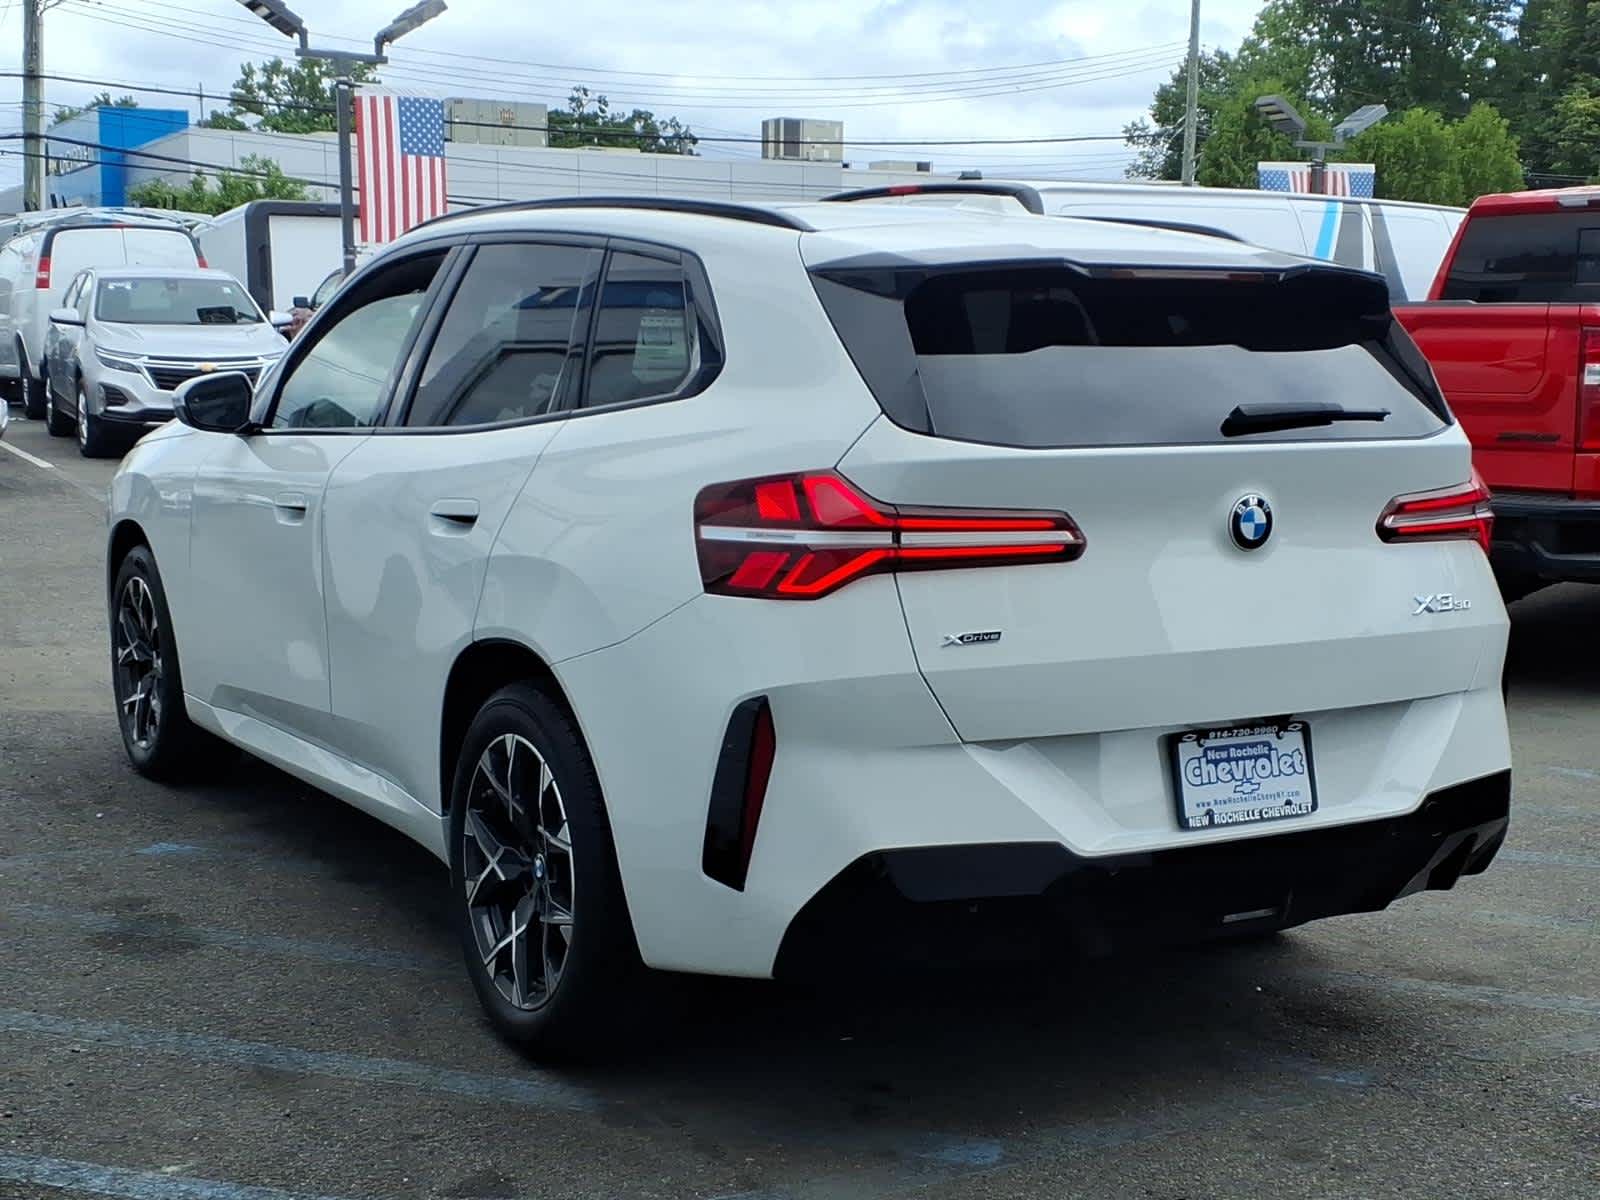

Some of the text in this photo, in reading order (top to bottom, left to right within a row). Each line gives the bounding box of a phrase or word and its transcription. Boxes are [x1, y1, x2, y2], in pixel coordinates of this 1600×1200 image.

[1207, 746, 1270, 761] New Rochelle
[1185, 748, 1305, 787] Chevrolet
[1189, 803, 1312, 828] NEW ROCHELLE CHEVROLET
